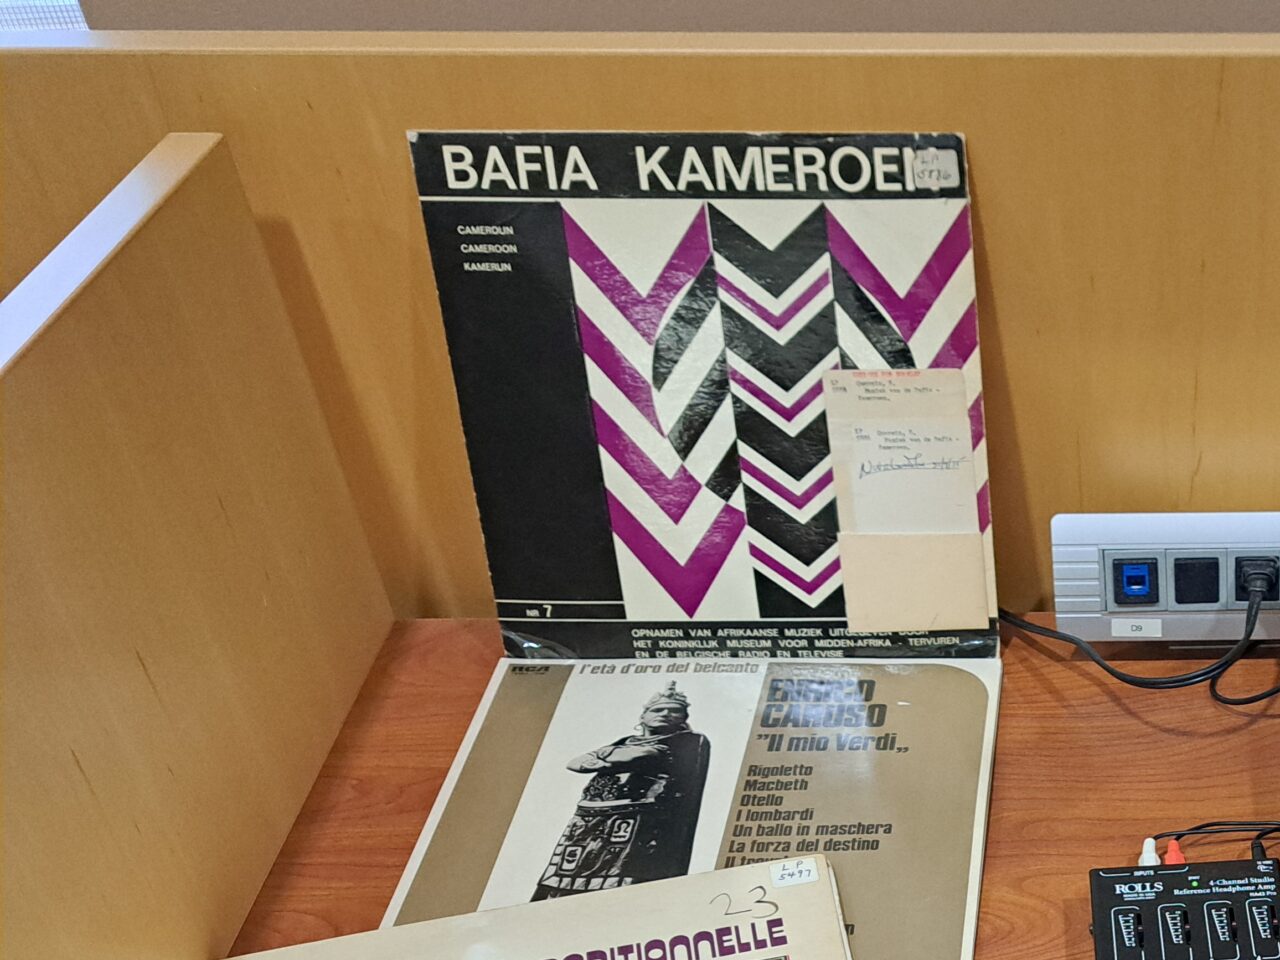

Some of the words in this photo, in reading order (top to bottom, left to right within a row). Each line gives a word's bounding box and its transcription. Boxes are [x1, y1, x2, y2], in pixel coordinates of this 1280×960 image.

[442, 145, 598, 191] BAFIA
[457, 225, 514, 235] CAMEROUN
[460, 244, 518, 254] CAMEROON
[463, 262, 512, 272] KAMERUN
[543, 604, 553, 618] 7
[631, 628, 684, 638] OPNAMEN
[688, 628, 712, 638] VAN
[716, 628, 779, 638] AFRIKAANSE
[783, 628, 823, 637] MUZIEK
[1130, 624, 1143, 632] D9
[633, 639, 651, 648] HET
[659, 639, 719, 648] KONINKLIJK
[726, 639, 772, 648] MUSEUM
[778, 639, 808, 648] VOOR
[908, 637, 960, 646] TERVUREN
[635, 650, 649, 658] EN
[655, 650, 670, 658] DE
[676, 650, 731, 658] BELGISCHE
[738, 650, 771, 658] RADIO
[777, 650, 791, 658] EN
[797, 650, 844, 658] TELEVISIE
[620, 662, 660, 675] d'oro
[665, 662, 691, 674] del
[693, 662, 760, 674] belcanto
[760, 703, 888, 728] CARUSO
[787, 733, 829, 752] mio
[746, 764, 814, 779] Rigoletto
[743, 779, 809, 792] Macbeth
[740, 794, 784, 807] Otello
[735, 809, 742, 822] I
[745, 808, 814, 822] lombardi
[732, 824, 752, 837] Un
[756, 823, 792, 837] ballo
[796, 823, 810, 836] in
[815, 822, 893, 836] maschera
[728, 840, 746, 853] La
[749, 839, 791, 853] forza
[795, 838, 820, 852] del
[822, 837, 880, 852] destino
[778, 868, 812, 881] 5497
[1209, 877, 1249, 886] 4-Channel
[1249, 876, 1275, 884] Studio
[1114, 881, 1164, 895] ROLLS
[1173, 888, 1211, 896] Reference
[1212, 885, 1256, 894] Headphone
[1257, 883, 1276, 892] Amp
[709, 885, 779, 919] 23
